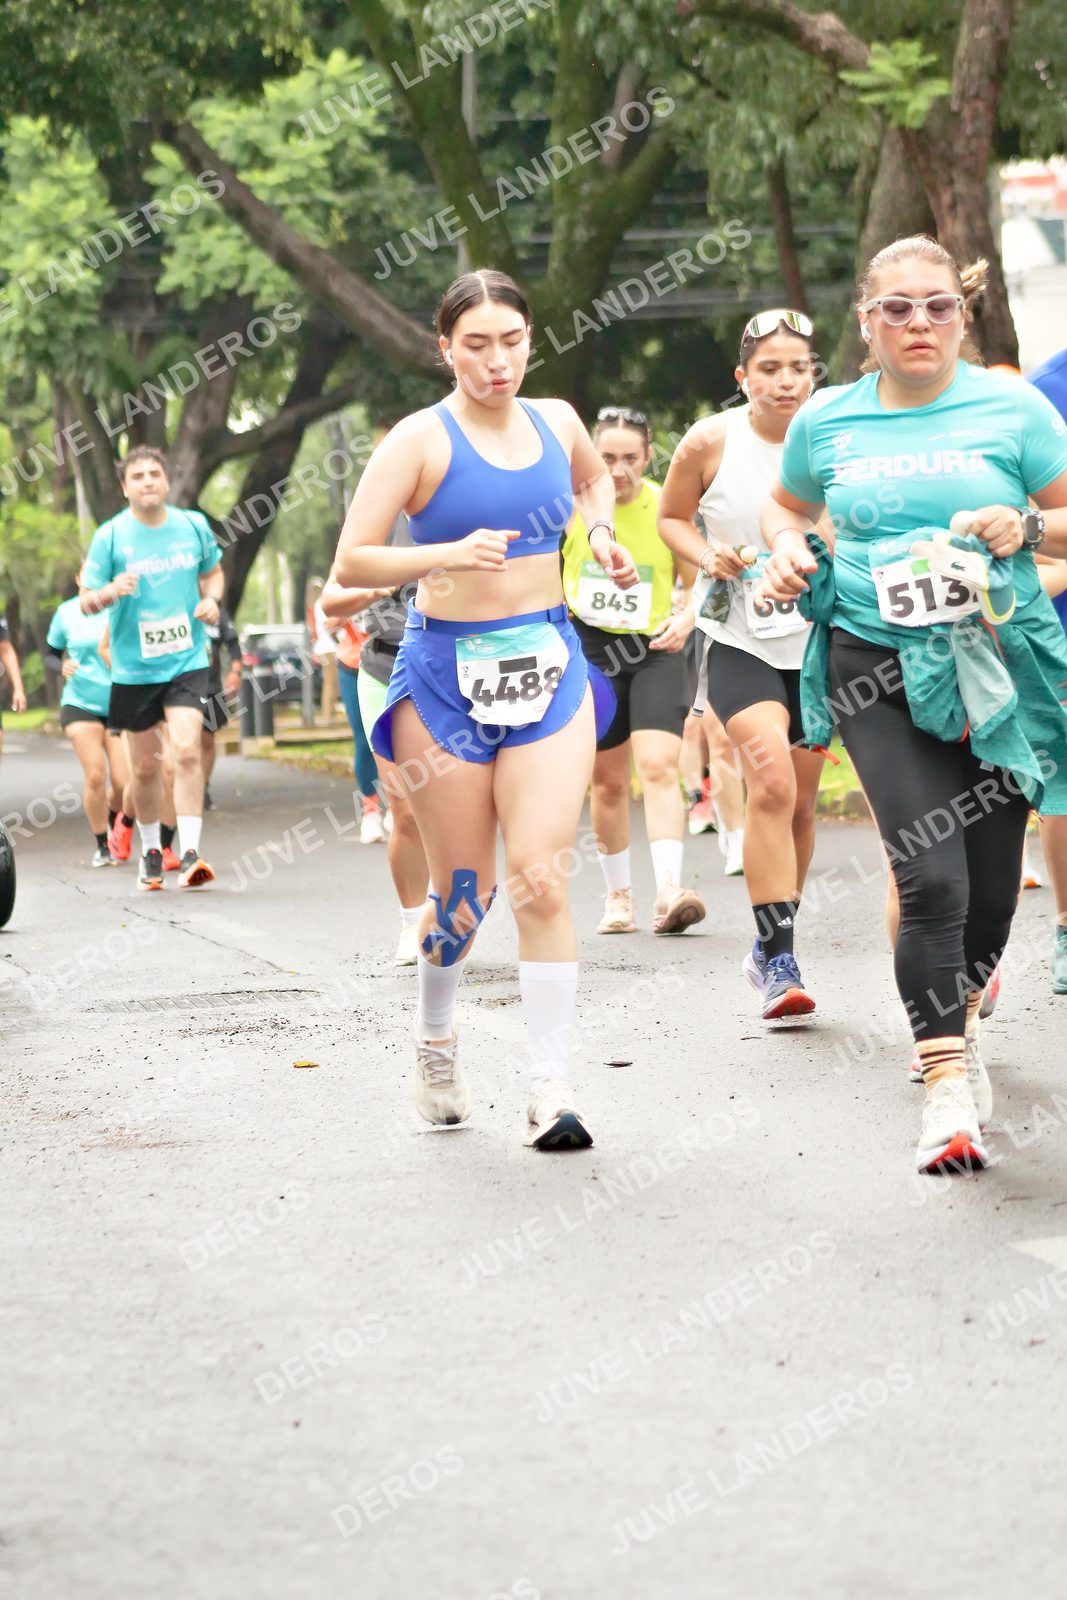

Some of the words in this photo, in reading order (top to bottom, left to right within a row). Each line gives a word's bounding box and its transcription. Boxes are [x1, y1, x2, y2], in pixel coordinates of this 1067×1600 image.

[591, 591, 638, 613] 845
[887, 575, 978, 619] 513
[145, 624, 188, 645] 5230
[471, 666, 562, 707] 4488
